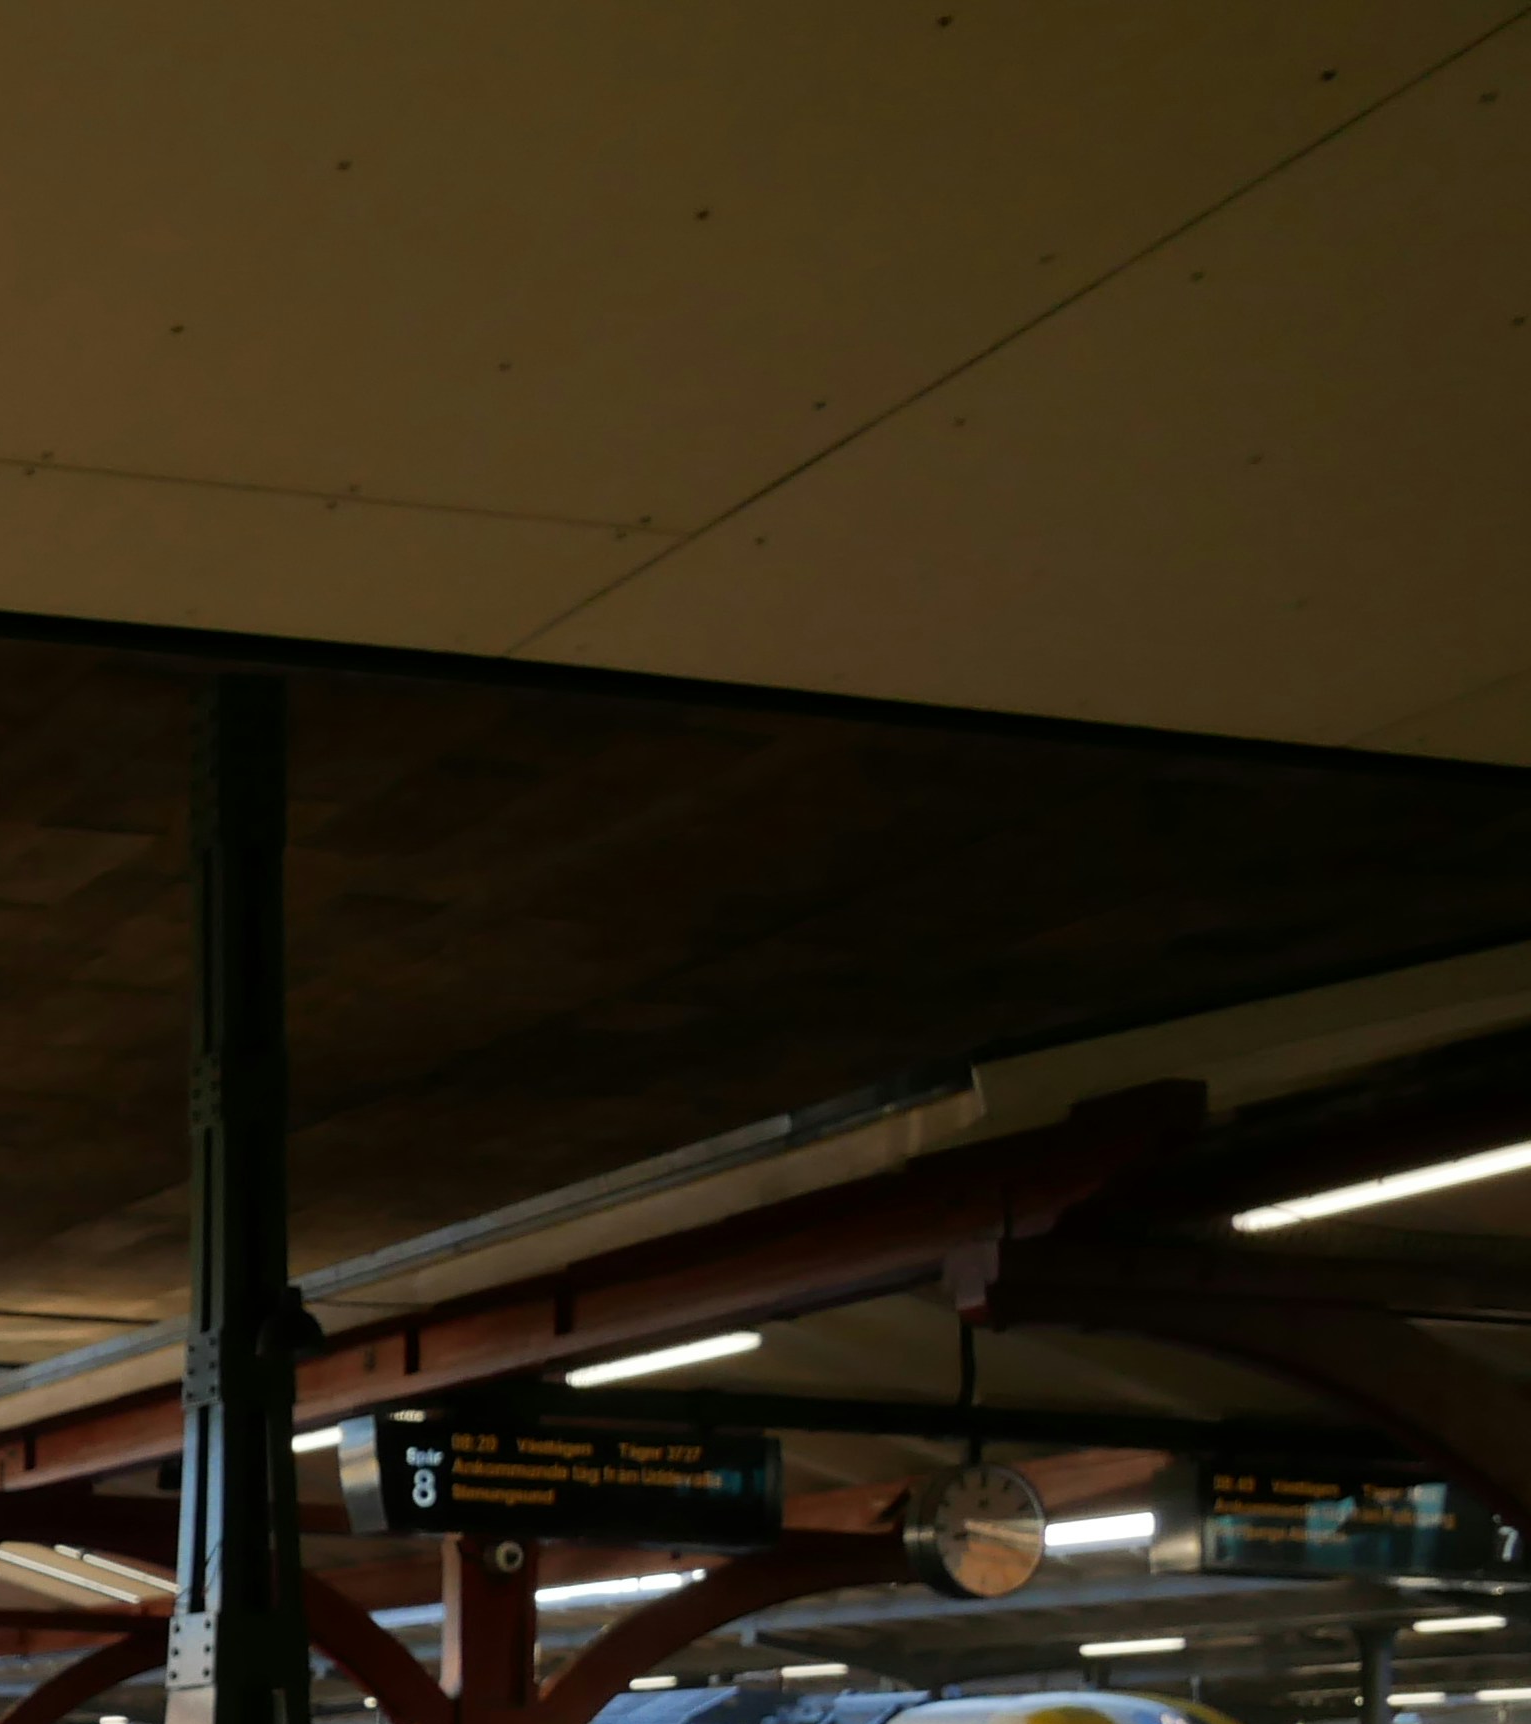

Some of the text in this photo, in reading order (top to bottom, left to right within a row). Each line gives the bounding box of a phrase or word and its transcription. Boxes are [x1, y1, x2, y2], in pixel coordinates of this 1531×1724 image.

[405, 1446, 445, 1468] Spår
[451, 1456, 570, 1481] Ankommande
[411, 1468, 438, 1509] 8
